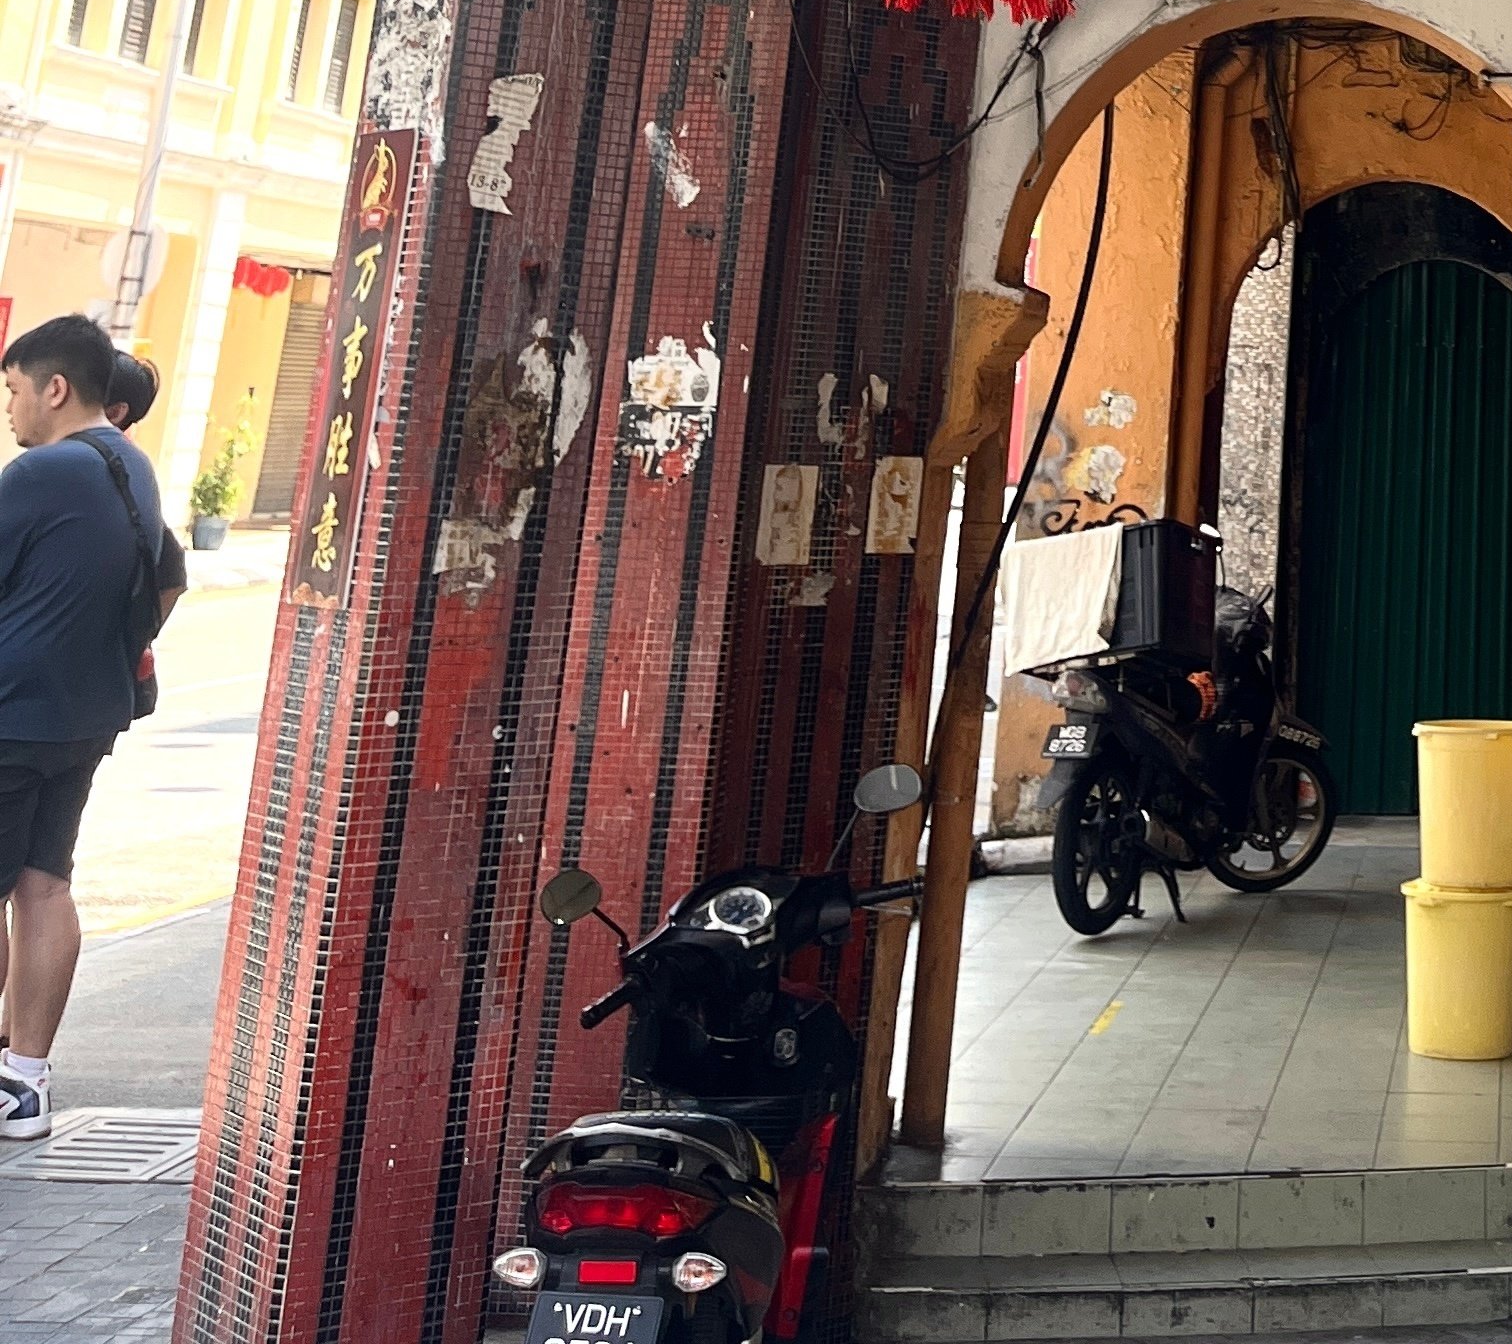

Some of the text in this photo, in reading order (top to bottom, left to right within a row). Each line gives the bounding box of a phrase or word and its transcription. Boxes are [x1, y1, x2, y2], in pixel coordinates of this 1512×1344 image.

[311, 243, 383, 572] 万事胜意
[564, 1302, 632, 1338] VDH
